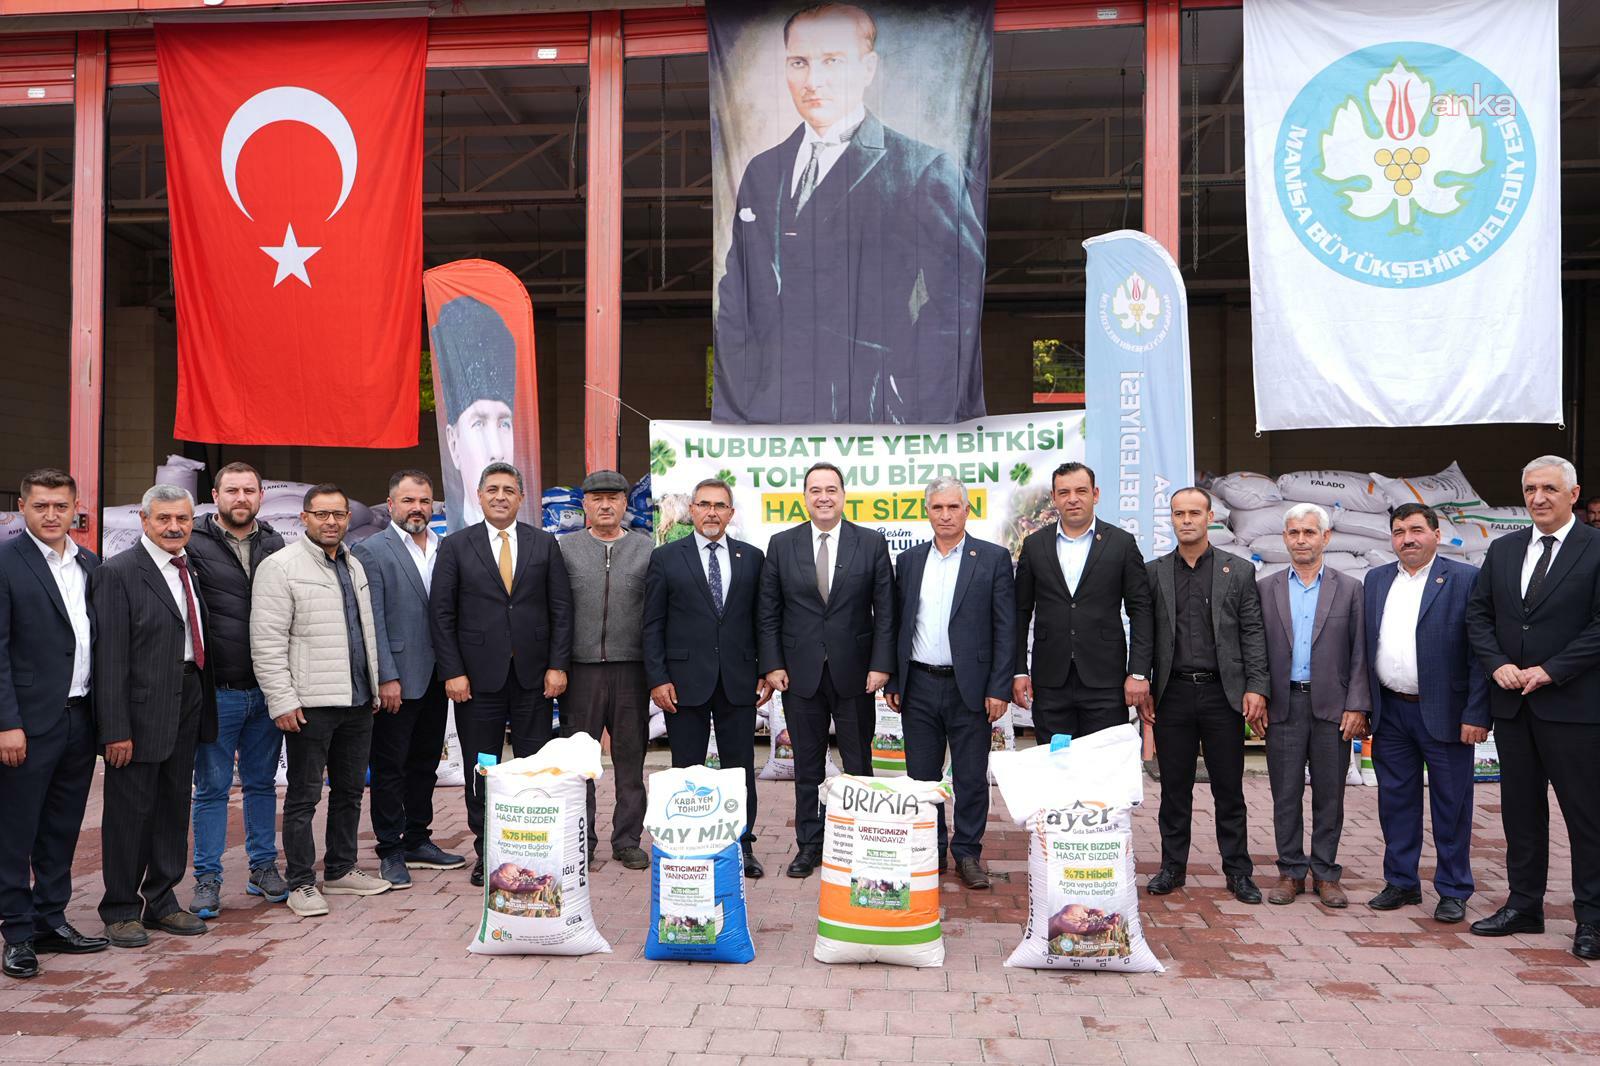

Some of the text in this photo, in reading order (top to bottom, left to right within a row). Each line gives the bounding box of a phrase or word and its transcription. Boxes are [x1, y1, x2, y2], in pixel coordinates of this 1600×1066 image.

[1284, 117, 1525, 284] MANİSA BÜYÜKŞEHİR BELEDİYESİ
[684, 421, 1064, 458] HUBUBAT VE YEM BİTKİSİ
[747, 457, 999, 488] TOHMU BİZDEN
[1310, 479, 1346, 489] FALADO
[766, 499, 864, 521] HAT
[674, 797, 696, 805] KABA
[842, 785, 919, 815] BRIXIA
[495, 803, 525, 814] DESTEK
[677, 804, 711, 813] TOHUMU
[496, 813, 523, 823] HASAT
[502, 829, 548, 841] %75 Hibeli
[646, 818, 739, 843] HAY MİX
[1053, 841, 1089, 851] DESTEK
[578, 817, 586, 888] FALADO
[1056, 851, 1087, 861] HASAT
[1064, 868, 1113, 879] %75 Hibeli
[1058, 880, 1119, 889] Arpa veya Buğday
[1062, 887, 1115, 896] Tohumu Desteği
